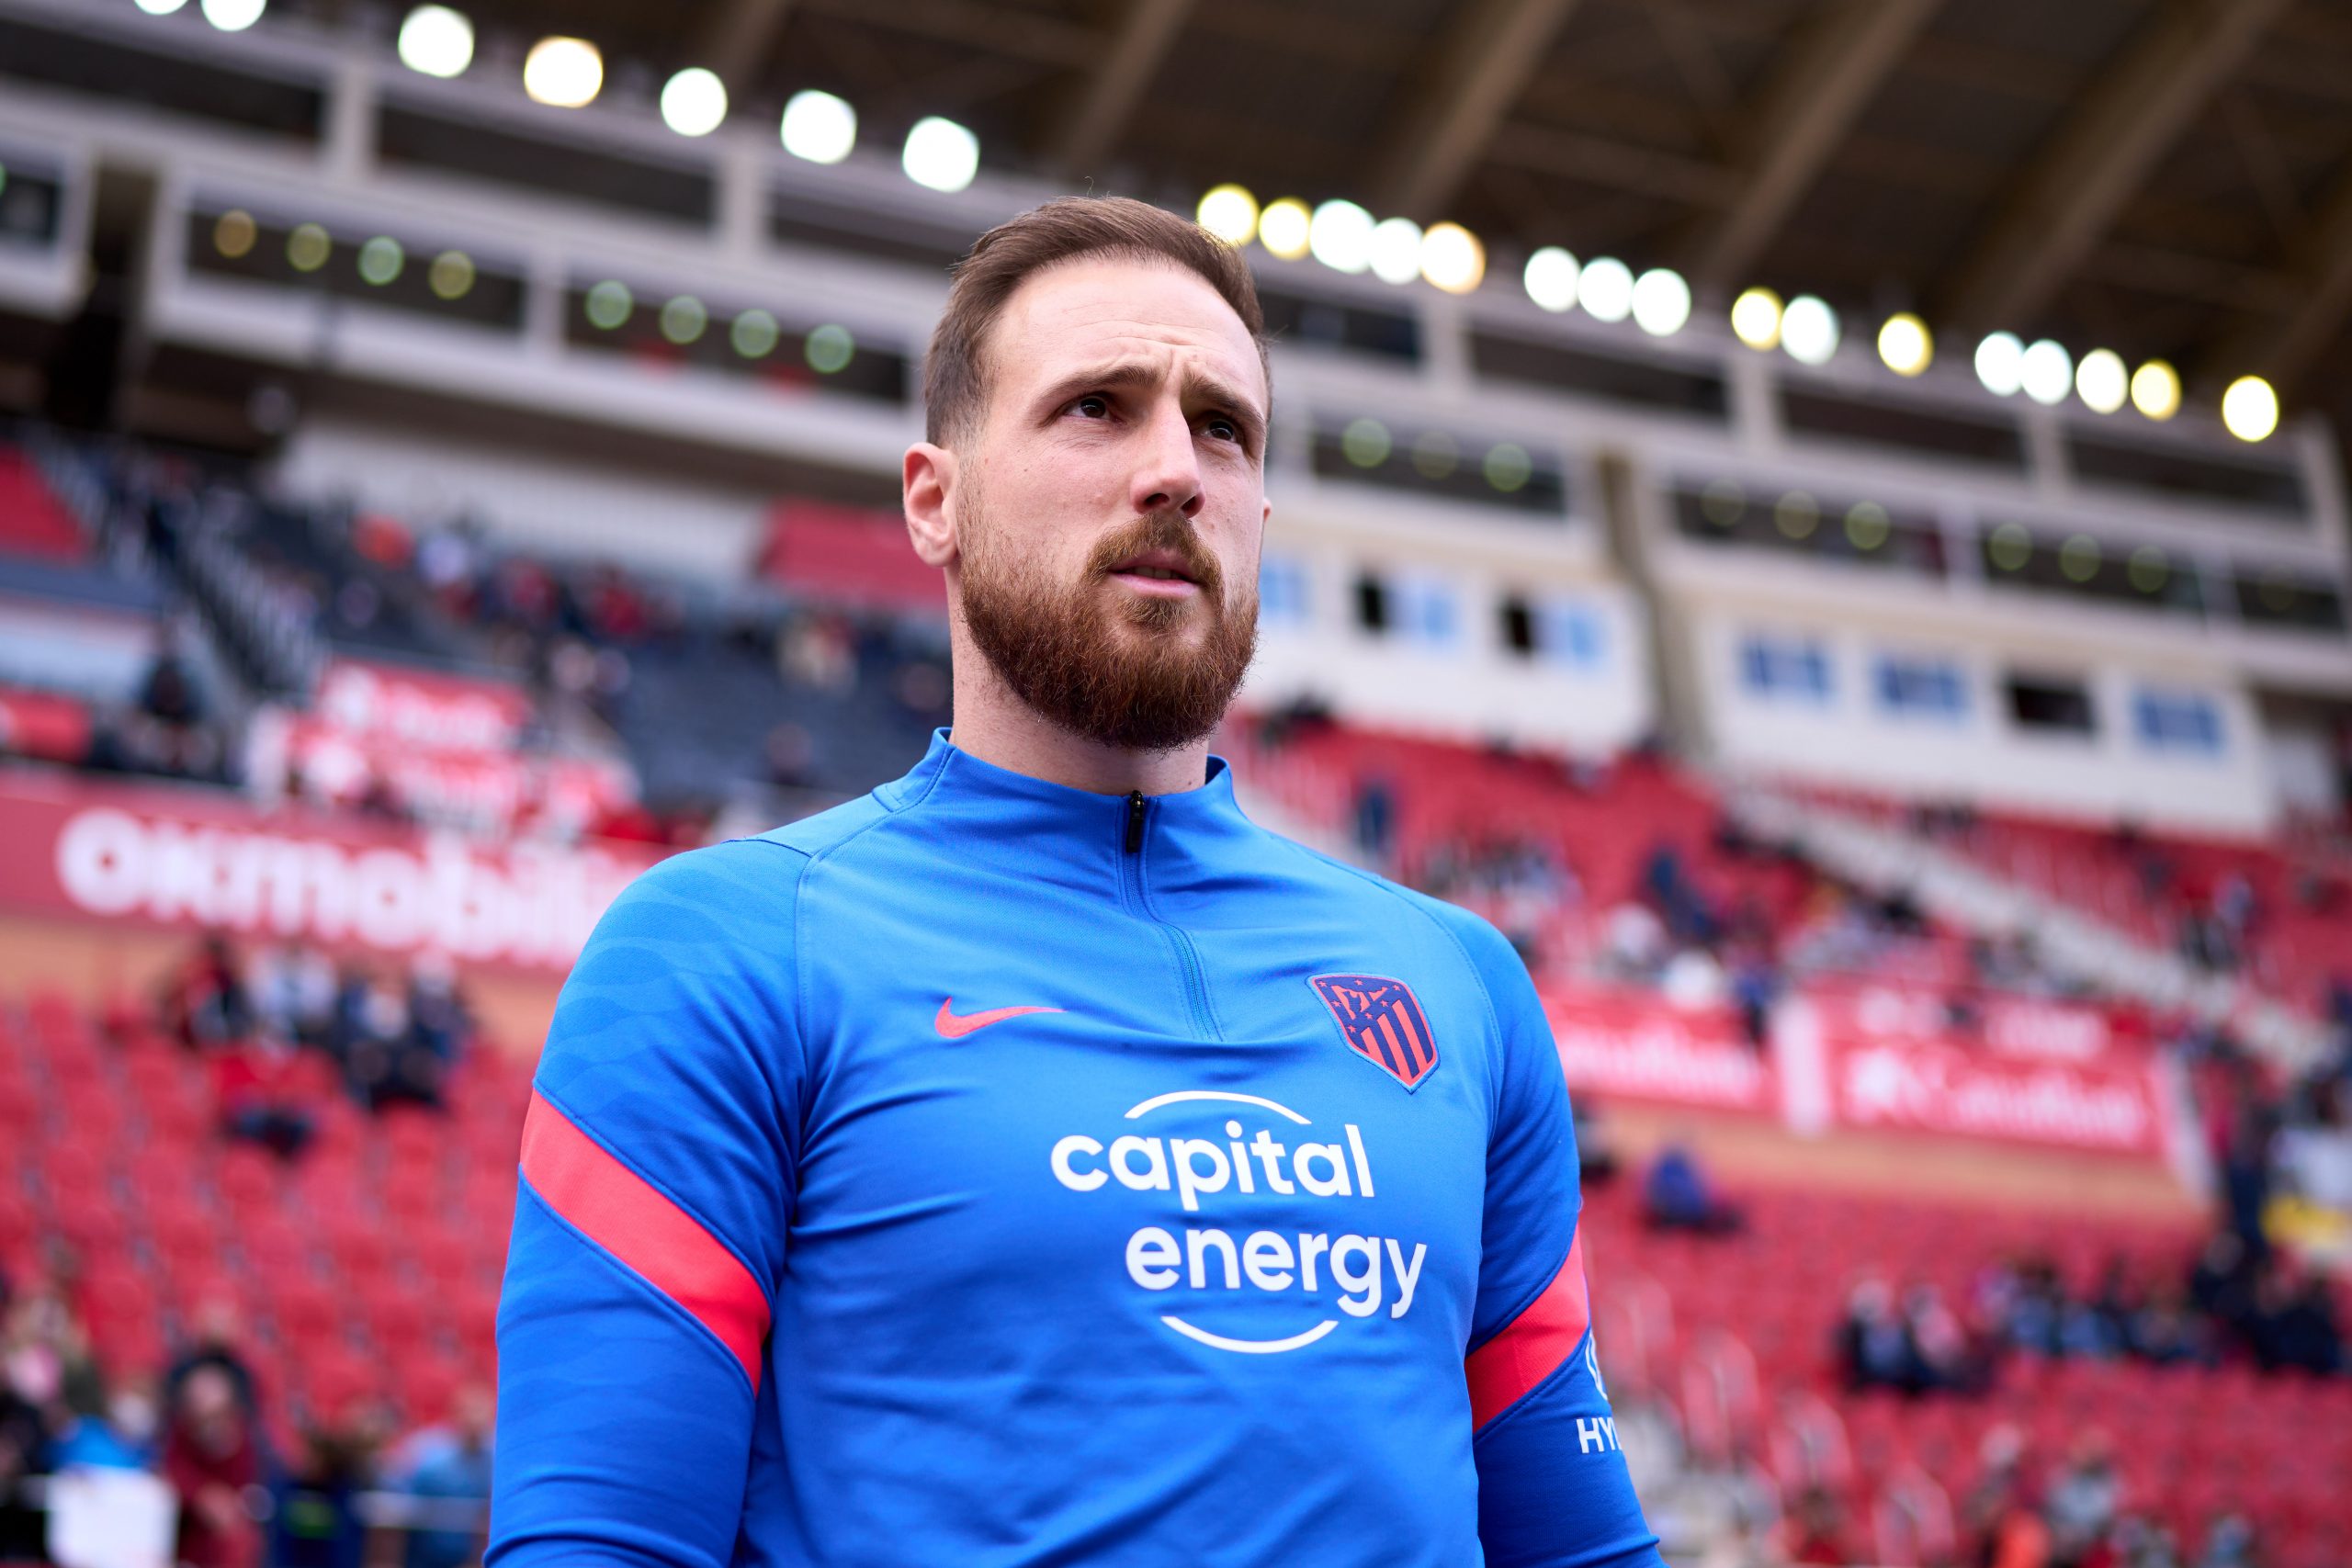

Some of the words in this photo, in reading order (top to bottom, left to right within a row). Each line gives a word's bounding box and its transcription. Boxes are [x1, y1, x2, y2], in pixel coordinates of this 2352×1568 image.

[1050, 1120, 1375, 1212] capital
[1125, 1226, 1428, 1319] energy
[1576, 1416, 1623, 1454] HY
